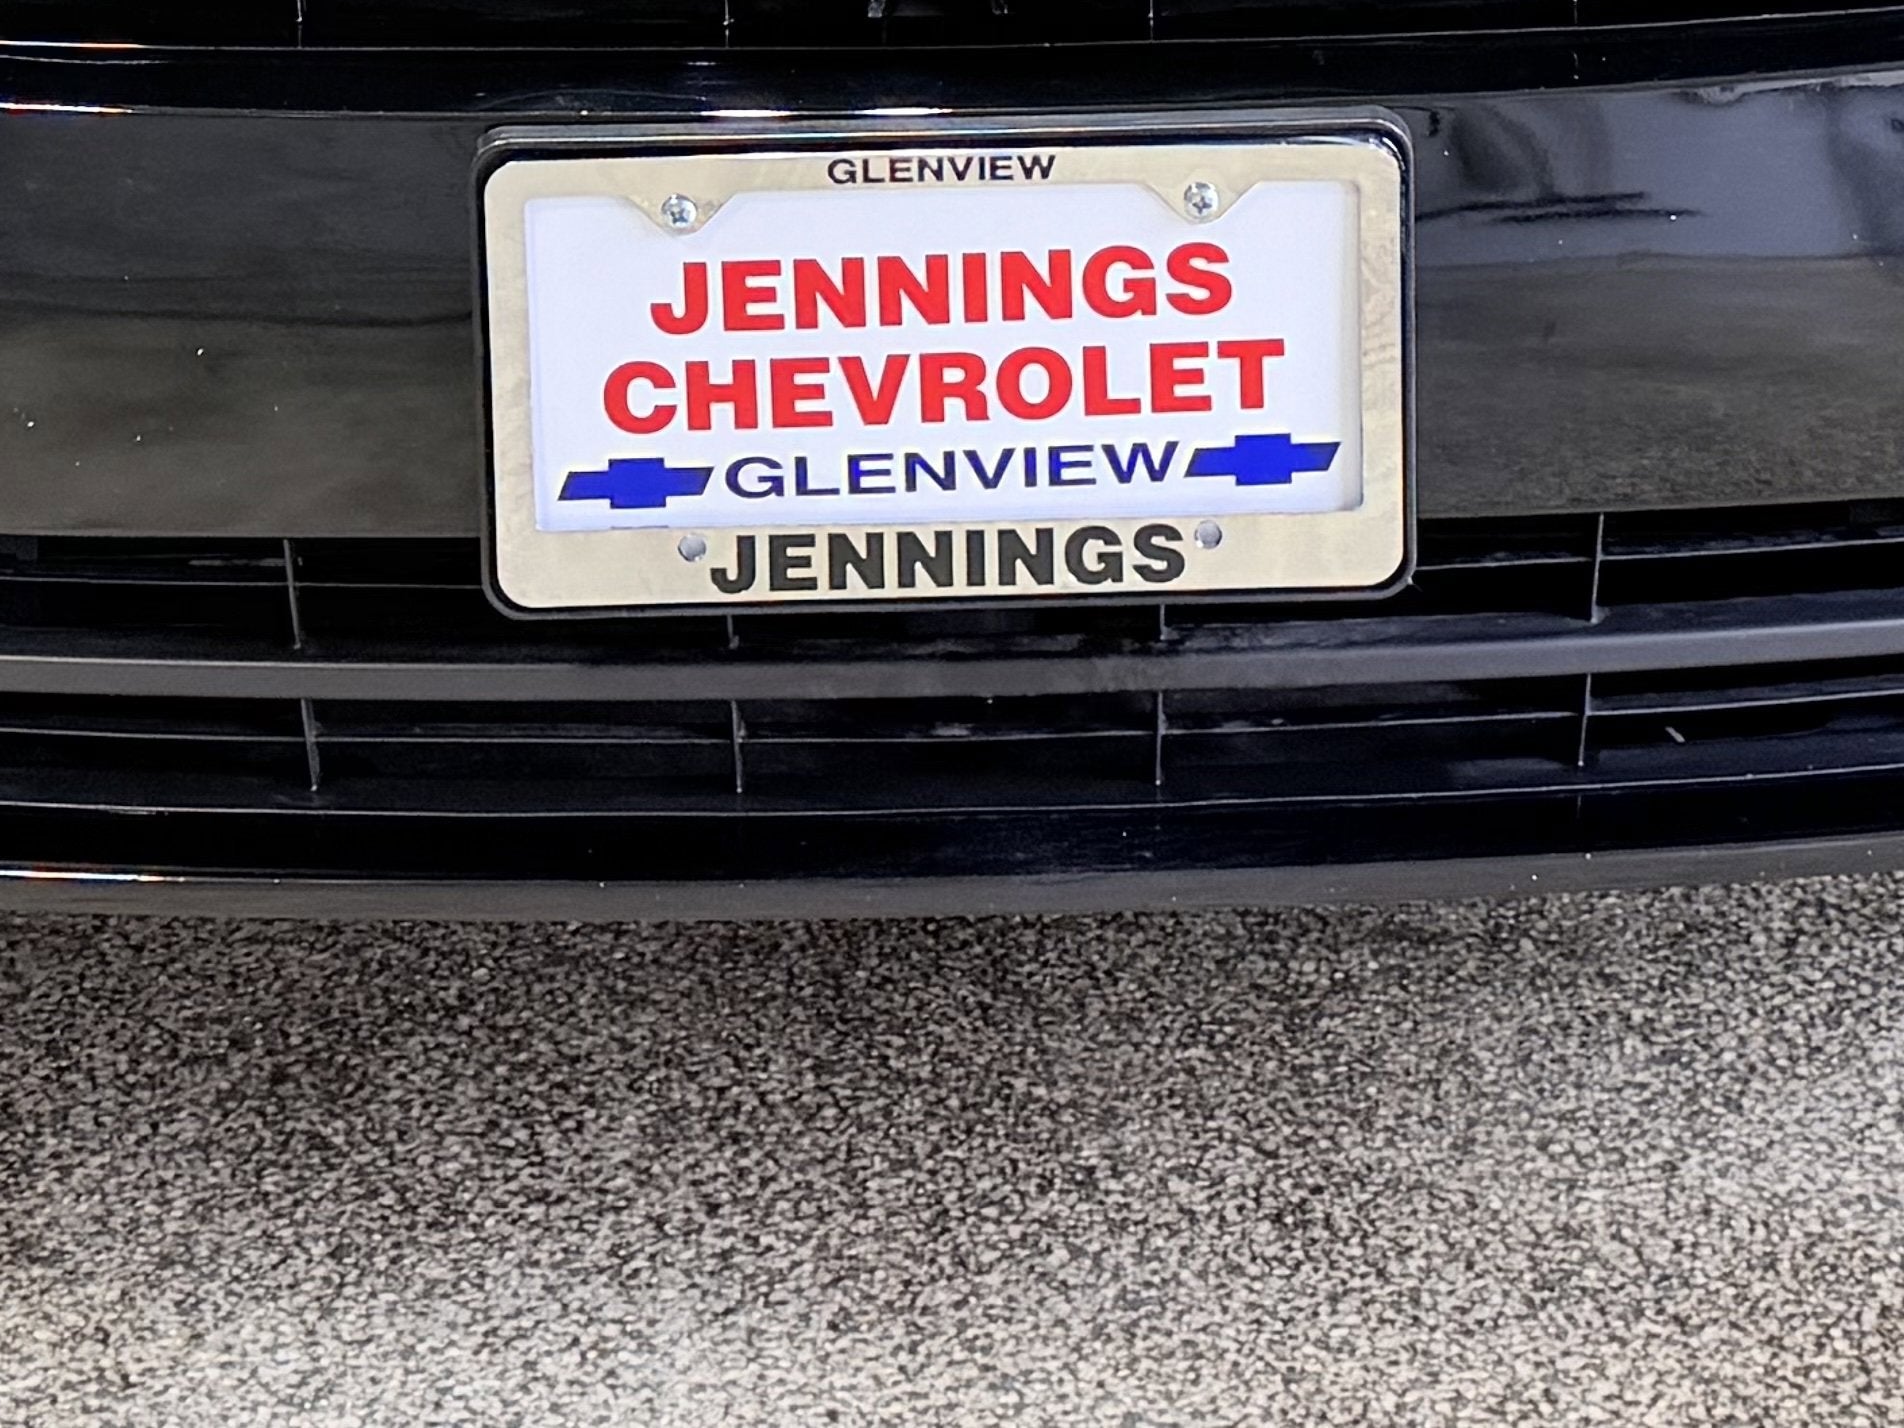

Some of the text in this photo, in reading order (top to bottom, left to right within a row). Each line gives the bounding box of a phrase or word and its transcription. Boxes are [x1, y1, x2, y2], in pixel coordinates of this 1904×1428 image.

[826, 154, 1057, 185] GLENVIEW
[649, 242, 1233, 336] JENNINGS
[602, 338, 1286, 435] CHEVROLET
[724, 441, 1180, 499] GLENVIEW
[709, 523, 1186, 594] JENNINGS
